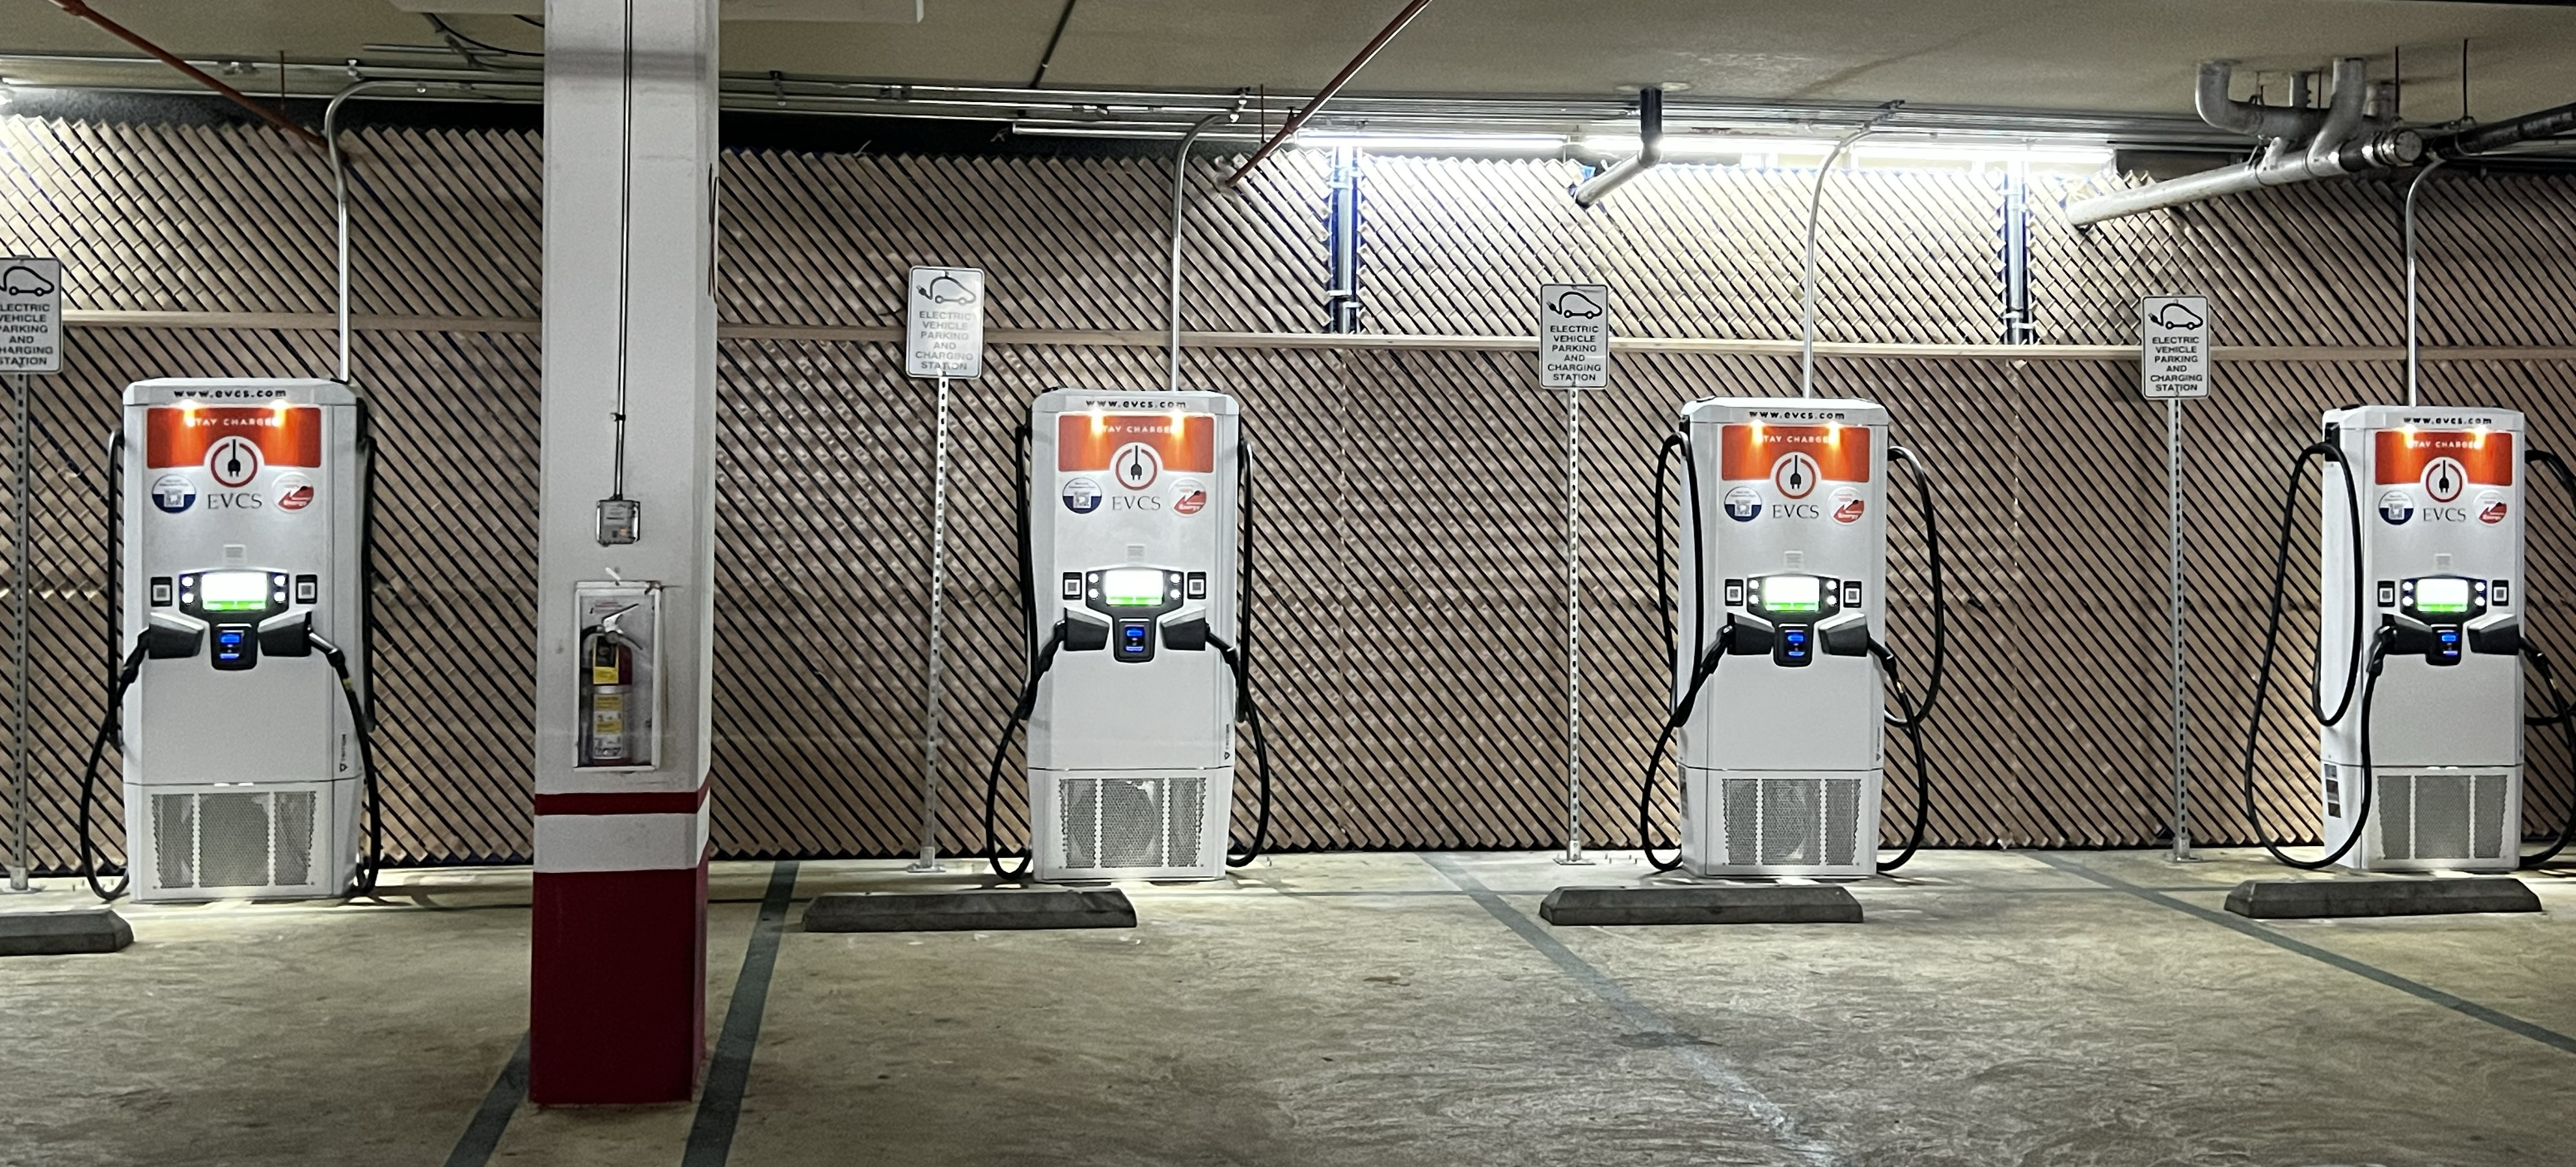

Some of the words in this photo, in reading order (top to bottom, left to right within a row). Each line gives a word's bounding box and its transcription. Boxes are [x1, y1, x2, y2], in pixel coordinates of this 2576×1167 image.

[0, 303, 50, 312] LECTRIC
[919, 311, 972, 320] ELECTRIC
[0, 325, 48, 333] ARKING
[922, 321, 968, 330] VEHICLE
[921, 331, 969, 340] PARKING
[0, 346, 53, 355] HARGING
[933, 342, 956, 350] AND
[915, 351, 973, 361] CHARGING
[921, 361, 967, 370] STATION
[1749, 411, 1845, 420] www.evcs.com
[190, 417, 217, 426] TAY
[207, 493, 262, 510] EVCS
[1111, 495, 1161, 512] EVCS
[1772, 504, 1819, 519] EVCS
[2422, 507, 2466, 521] EVCS
